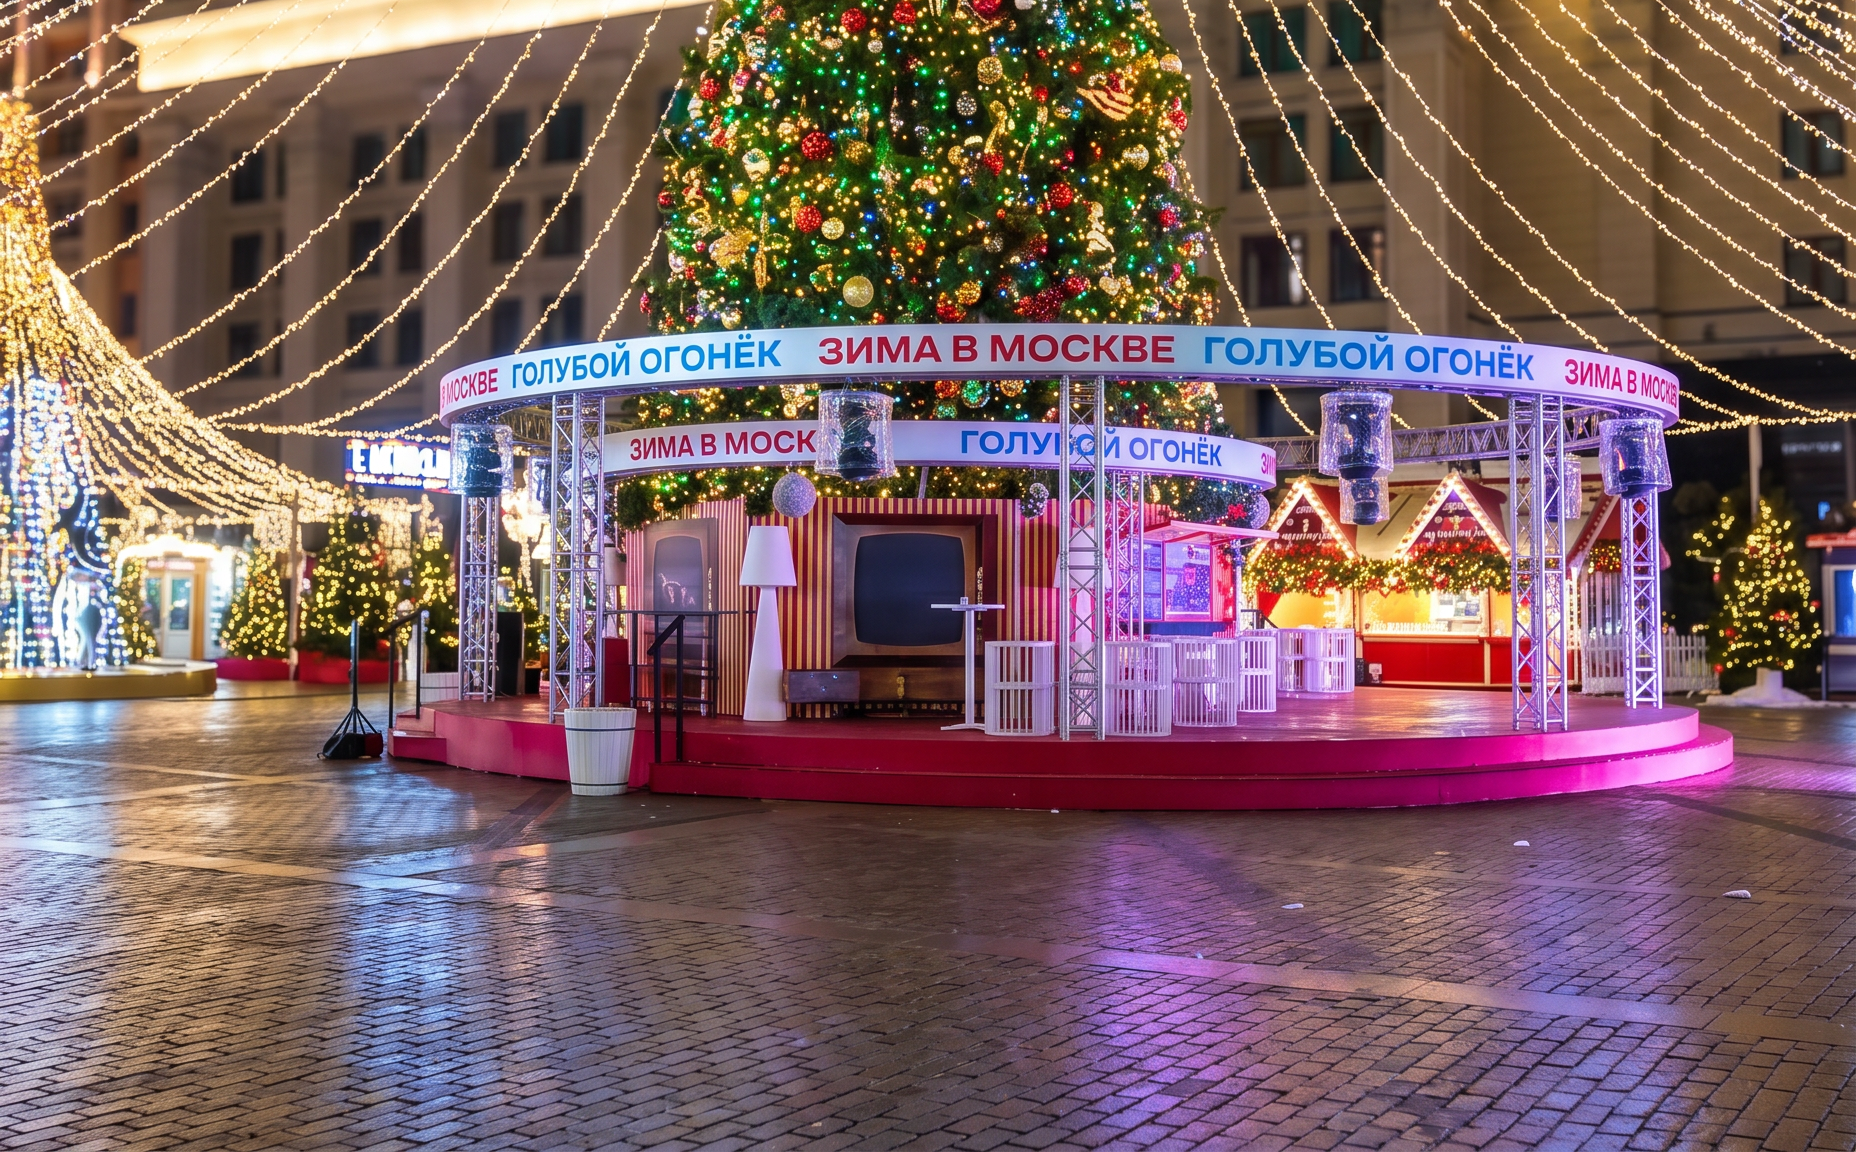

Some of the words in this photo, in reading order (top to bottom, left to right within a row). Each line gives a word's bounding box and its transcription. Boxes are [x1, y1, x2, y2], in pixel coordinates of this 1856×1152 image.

[512, 341, 630, 389] ГОЛУБОЙ
[639, 333, 782, 374] ОГОНЁК
[818, 336, 942, 365] ЗИМА
[952, 335, 979, 363] В
[990, 334, 1175, 363] МОСКВЕ
[1203, 334, 1394, 372] ГОЛУБОЙ
[1404, 344, 1535, 381] ОГОНЁК
[446, 368, 499, 405] МОСКВЕ
[1564, 358, 1623, 392] ЗИМА
[1627, 369, 1638, 394] В
[629, 434, 694, 461] ЗИМА
[700, 433, 717, 456] В
[725, 429, 817, 454] МОСК
[1129, 436, 1223, 467] ОГОНЁК
